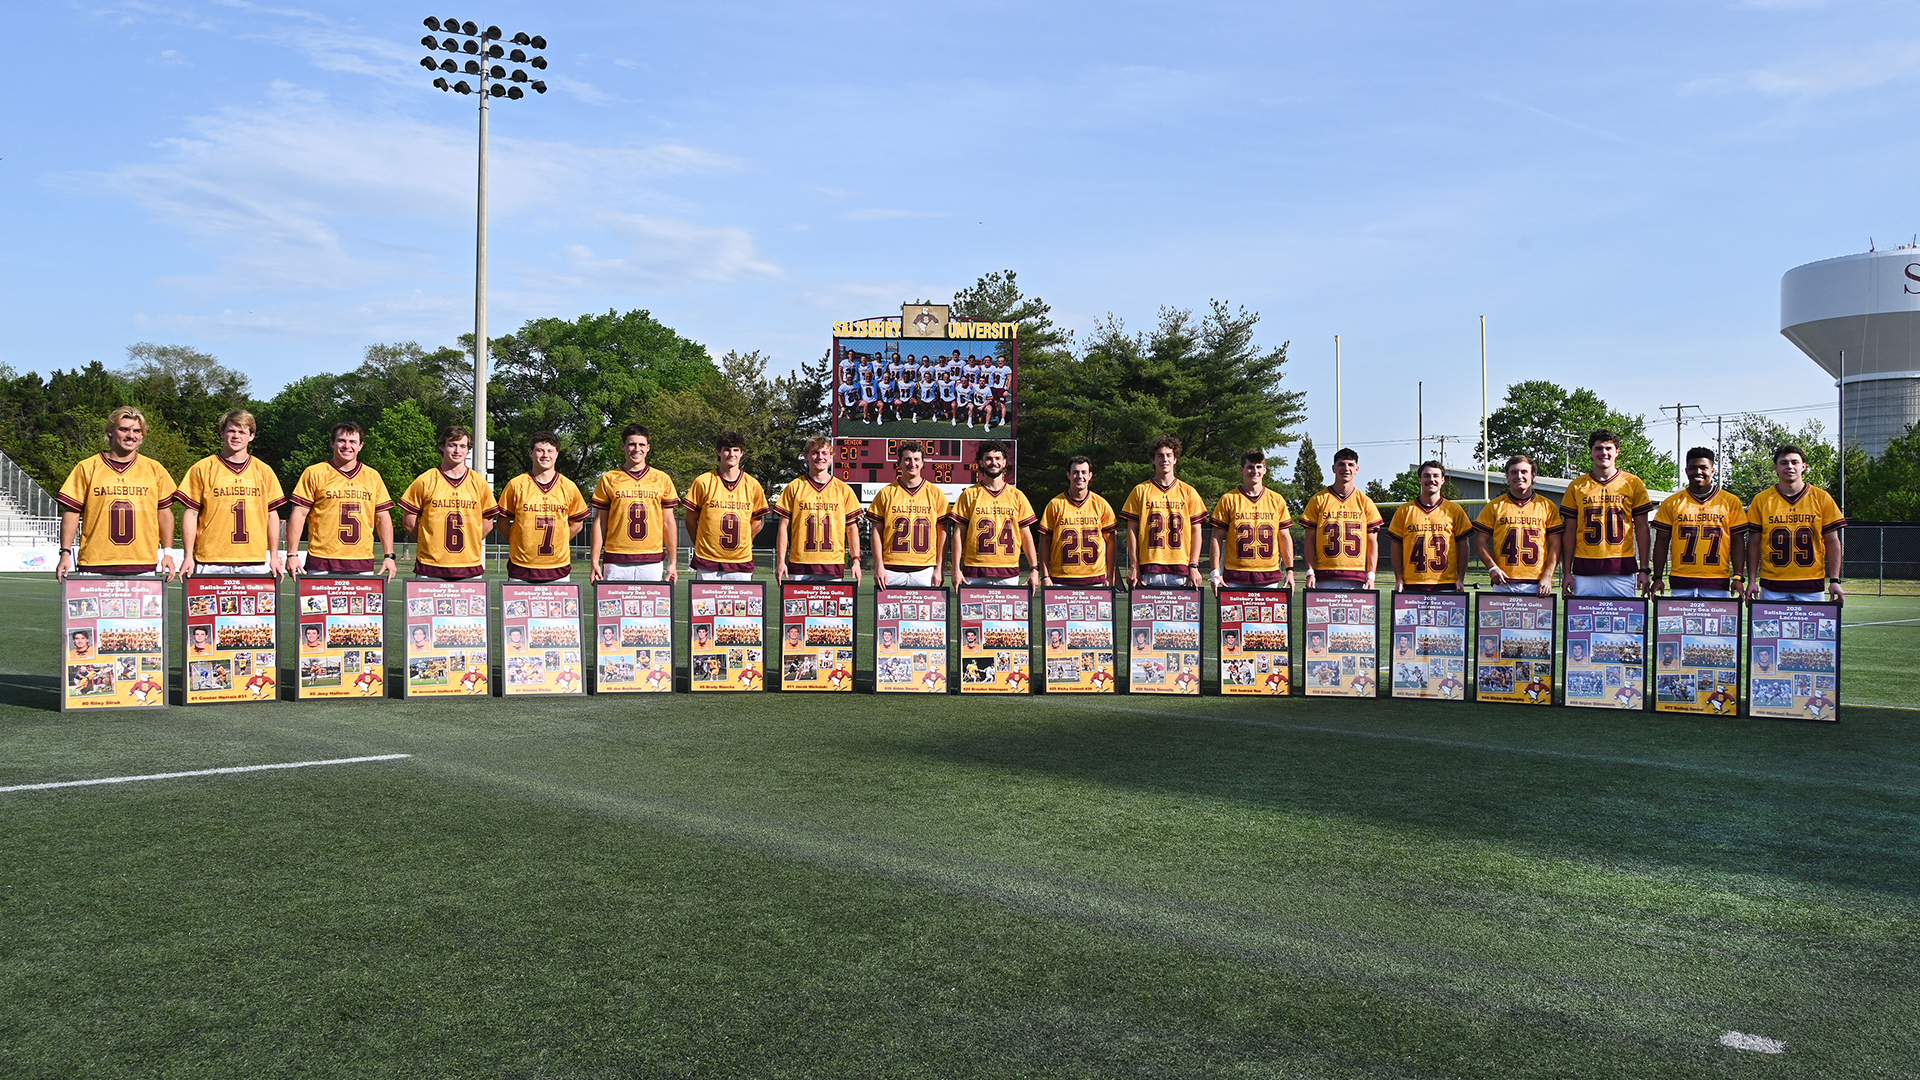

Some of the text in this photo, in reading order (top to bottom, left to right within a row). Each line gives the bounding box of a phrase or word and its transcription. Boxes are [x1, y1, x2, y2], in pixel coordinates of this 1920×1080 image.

[833, 321, 1019, 339] SALISBURY UNIVERSITY
[841, 447, 857, 459] 20
[935, 471, 951, 483] 26
[94, 486, 148, 497] SALISBURY
[213, 487, 261, 497] SALISBURY
[326, 490, 372, 501] SALISBURY
[616, 490, 658, 499] SALISBURY
[432, 499, 477, 509] SALISBURY
[710, 500, 751, 510] SALISBURY
[1146, 501, 1185, 510] SALISBURY
[1582, 495, 1625, 505] SALISBURY
[523, 503, 566, 513] SALISBURY
[799, 503, 838, 511] SALISBURY
[892, 506, 931, 514] SALISBURY
[976, 506, 1014, 515] SALISBURY
[231, 499, 249, 544] 1
[627, 501, 648, 541] 8
[1060, 517, 1099, 526] SALISBURY
[1236, 512, 1274, 520] SALISBURY
[1323, 511, 1362, 520] SALISBURY
[1500, 517, 1542, 525] SALISBURY
[1678, 514, 1724, 522] SALISBURY
[1769, 514, 1816, 524] SALISBURY
[109, 499, 135, 545] 0
[338, 502, 361, 545] 5
[1408, 523, 1448, 533] SALISBURY
[1583, 506, 1625, 546] 50
[444, 511, 465, 553] 6
[535, 515, 555, 556] 7
[719, 512, 741, 550] 9
[804, 513, 834, 552] 11
[890, 516, 931, 554] 20
[1147, 511, 1183, 549] 28
[977, 517, 1015, 556] 24
[1236, 522, 1275, 559] 29
[1322, 521, 1362, 558] 35
[1061, 528, 1099, 566] 25
[1500, 527, 1541, 566] 45
[1678, 525, 1722, 566] 77
[1769, 526, 1816, 567] 99
[1409, 534, 1448, 573] 43
